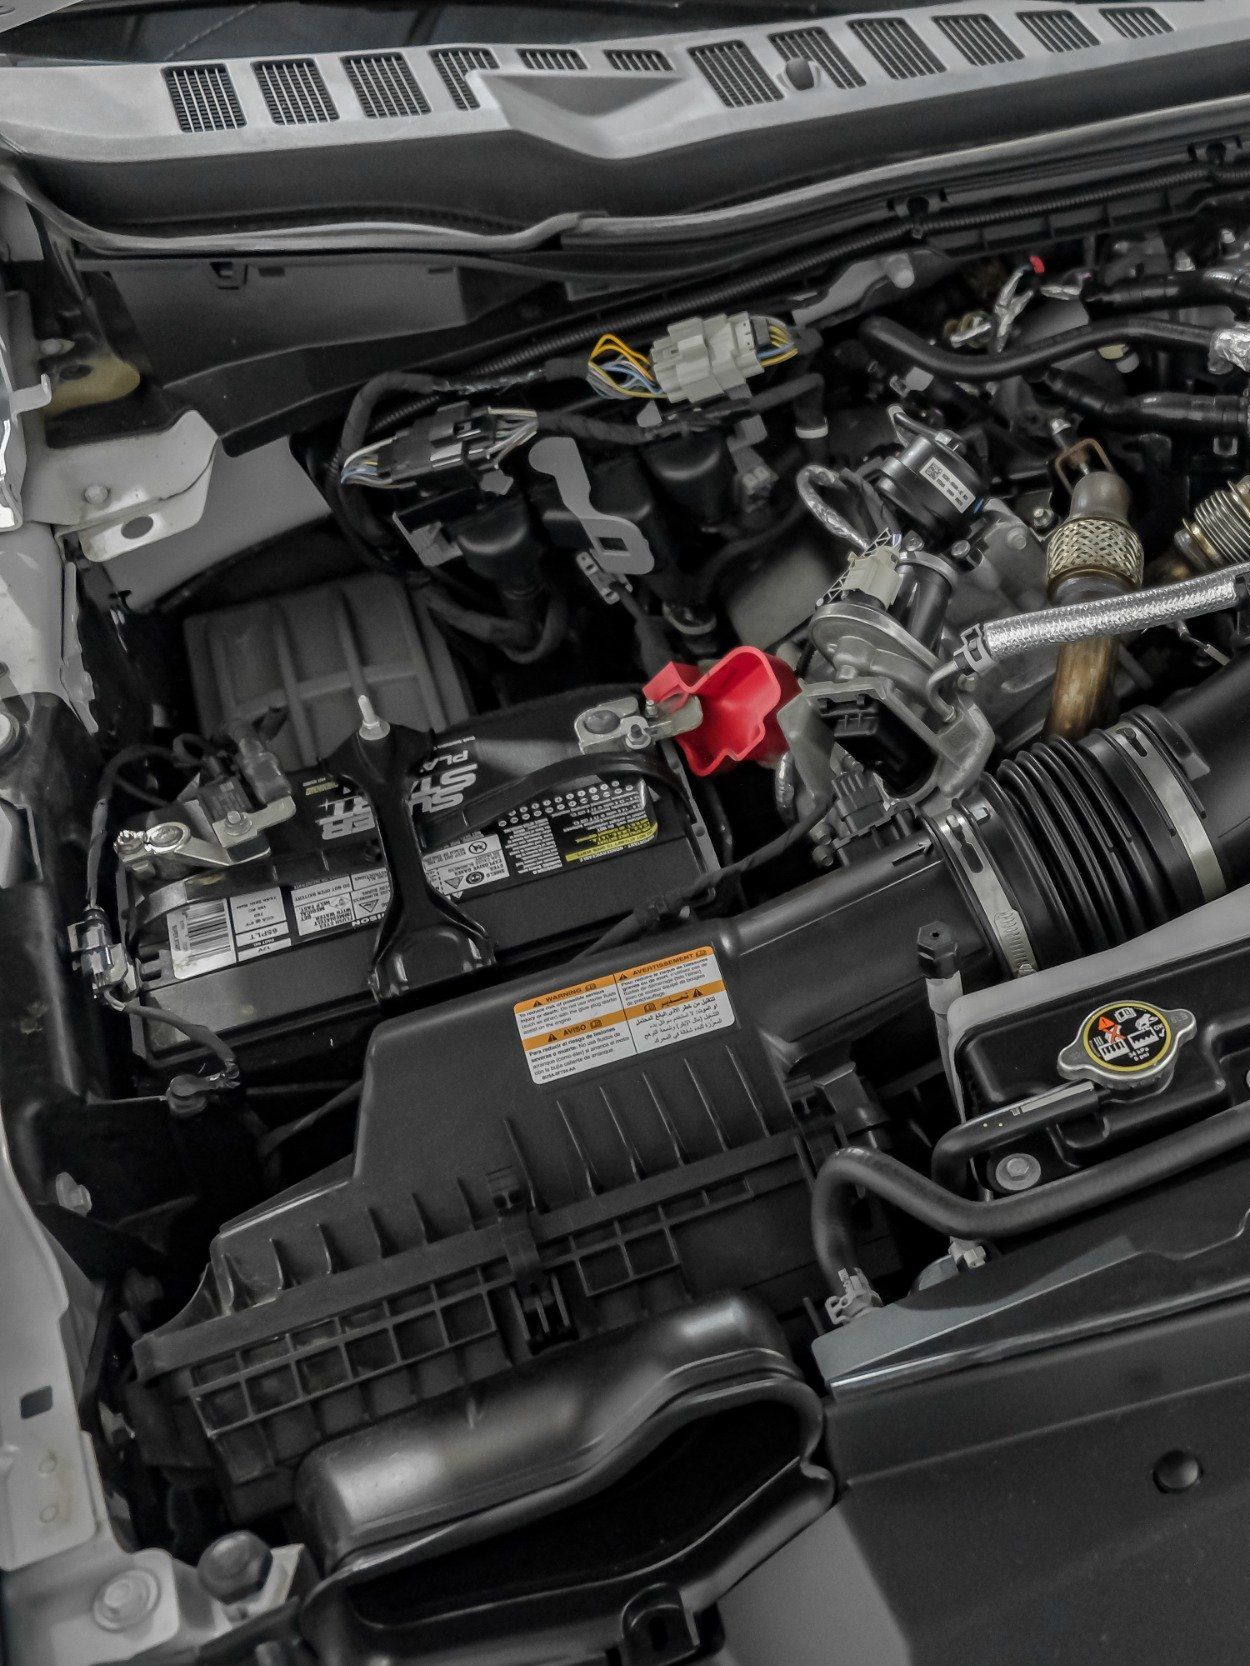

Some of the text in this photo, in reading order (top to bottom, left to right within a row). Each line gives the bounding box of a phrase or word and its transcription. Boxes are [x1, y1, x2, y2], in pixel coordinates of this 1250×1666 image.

[632, 954, 693, 975] AVERTISSEMENT
[682, 957, 708, 967] blessures
[545, 987, 582, 1002] WARNING
[526, 1007, 544, 1015] reduce
[562, 995, 585, 1005] possible
[585, 989, 604, 998] serious
[520, 1015, 535, 1023] injury
[562, 1026, 586, 1036] AVISO
[542, 1043, 560, 1052] reducir
[567, 1036, 585, 1045] riesgo
[593, 1026, 615, 1036] lesiones
[531, 1052, 552, 1062] severas
[532, 1059, 555, 1069] arranque
